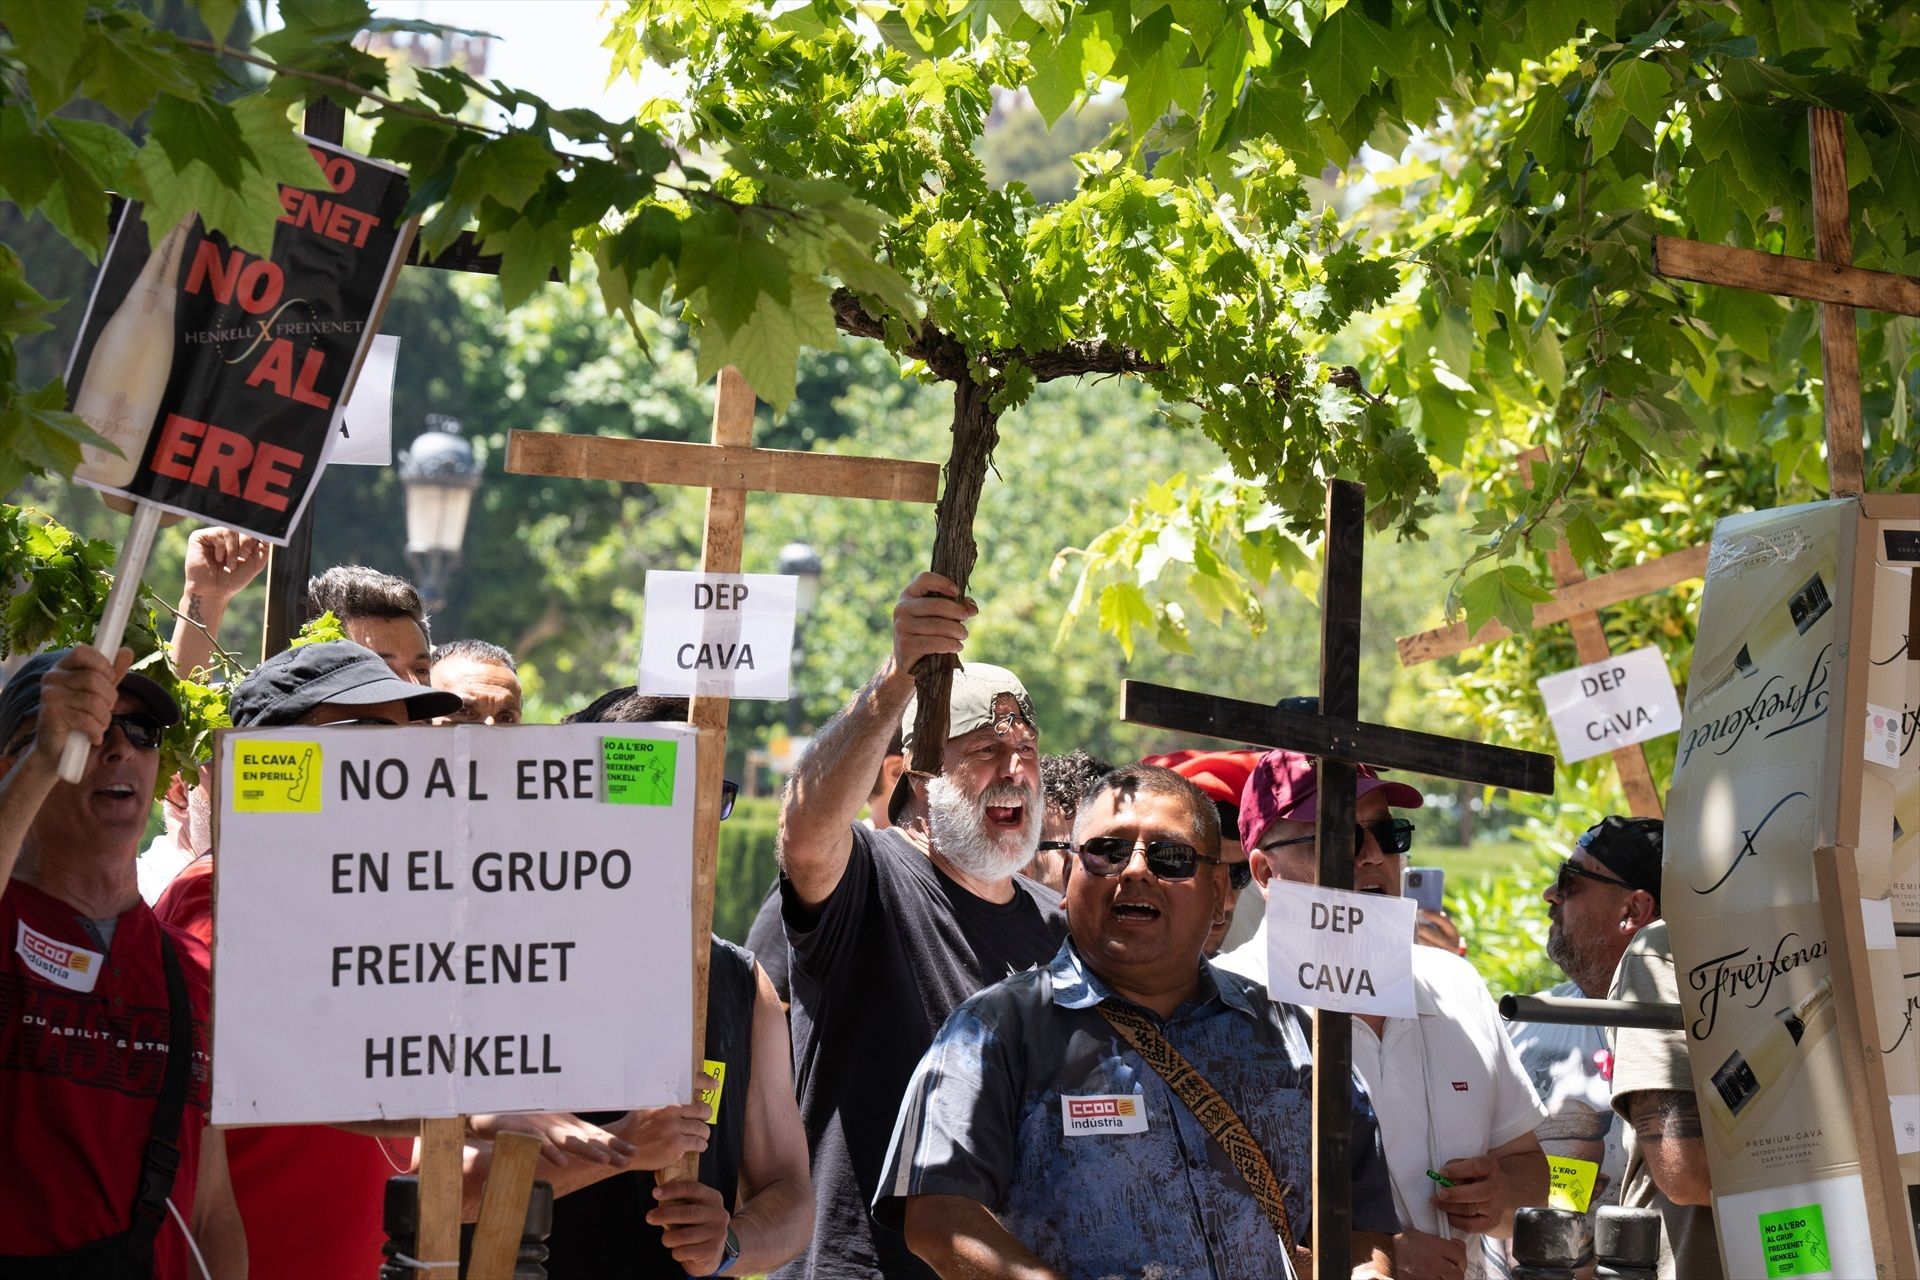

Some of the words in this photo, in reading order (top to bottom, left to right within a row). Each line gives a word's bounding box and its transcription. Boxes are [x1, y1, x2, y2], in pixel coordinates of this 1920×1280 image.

[276, 185, 381, 249] ENET
[184, 239, 285, 314] NO
[185, 326, 254, 344] HENKELL
[276, 320, 364, 336] FREIXENET
[246, 337, 332, 410] AL
[150, 412, 304, 512] ERE
[694, 583, 749, 610] DEP
[677, 643, 755, 670] CAVA
[1581, 667, 1626, 697] DEP
[1682, 643, 1832, 768] Freixenet
[1586, 706, 1653, 741] CAVA
[243, 754, 259, 765] EL
[261, 754, 297, 765] CAVA
[617, 742, 625, 750] A
[626, 743, 654, 752] L'ERO
[243, 771, 258, 780] EN
[260, 771, 295, 781] PERILL
[340, 758, 409, 800] NO
[516, 759, 594, 800] ERE
[606, 764, 645, 772] REIXENET
[332, 852, 389, 893] EN
[407, 850, 454, 891] EL
[471, 848, 632, 893] GRUPO
[1311, 902, 1364, 934] DEP
[24, 933, 68, 964] CCOO
[331, 941, 577, 988] FREIXENET
[1298, 962, 1376, 997] CAVA
[365, 1033, 562, 1079] HENKELL
[1071, 1101, 1116, 1115] CCOO
[1071, 1116, 1124, 1129] indústria
[1785, 1151, 1812, 1160] NEVADA
[1553, 1166, 1577, 1175] L'ERO
[1765, 1225, 1777, 1234] NO
[1778, 1223, 1784, 1231] A
[1784, 1219, 1806, 1231] L'ERO
[1767, 1236, 1776, 1244] AL
[1776, 1232, 1794, 1242] GRUP
[1768, 1240, 1804, 1253] FREIXENET
[1769, 1251, 1800, 1263] HENKELL
